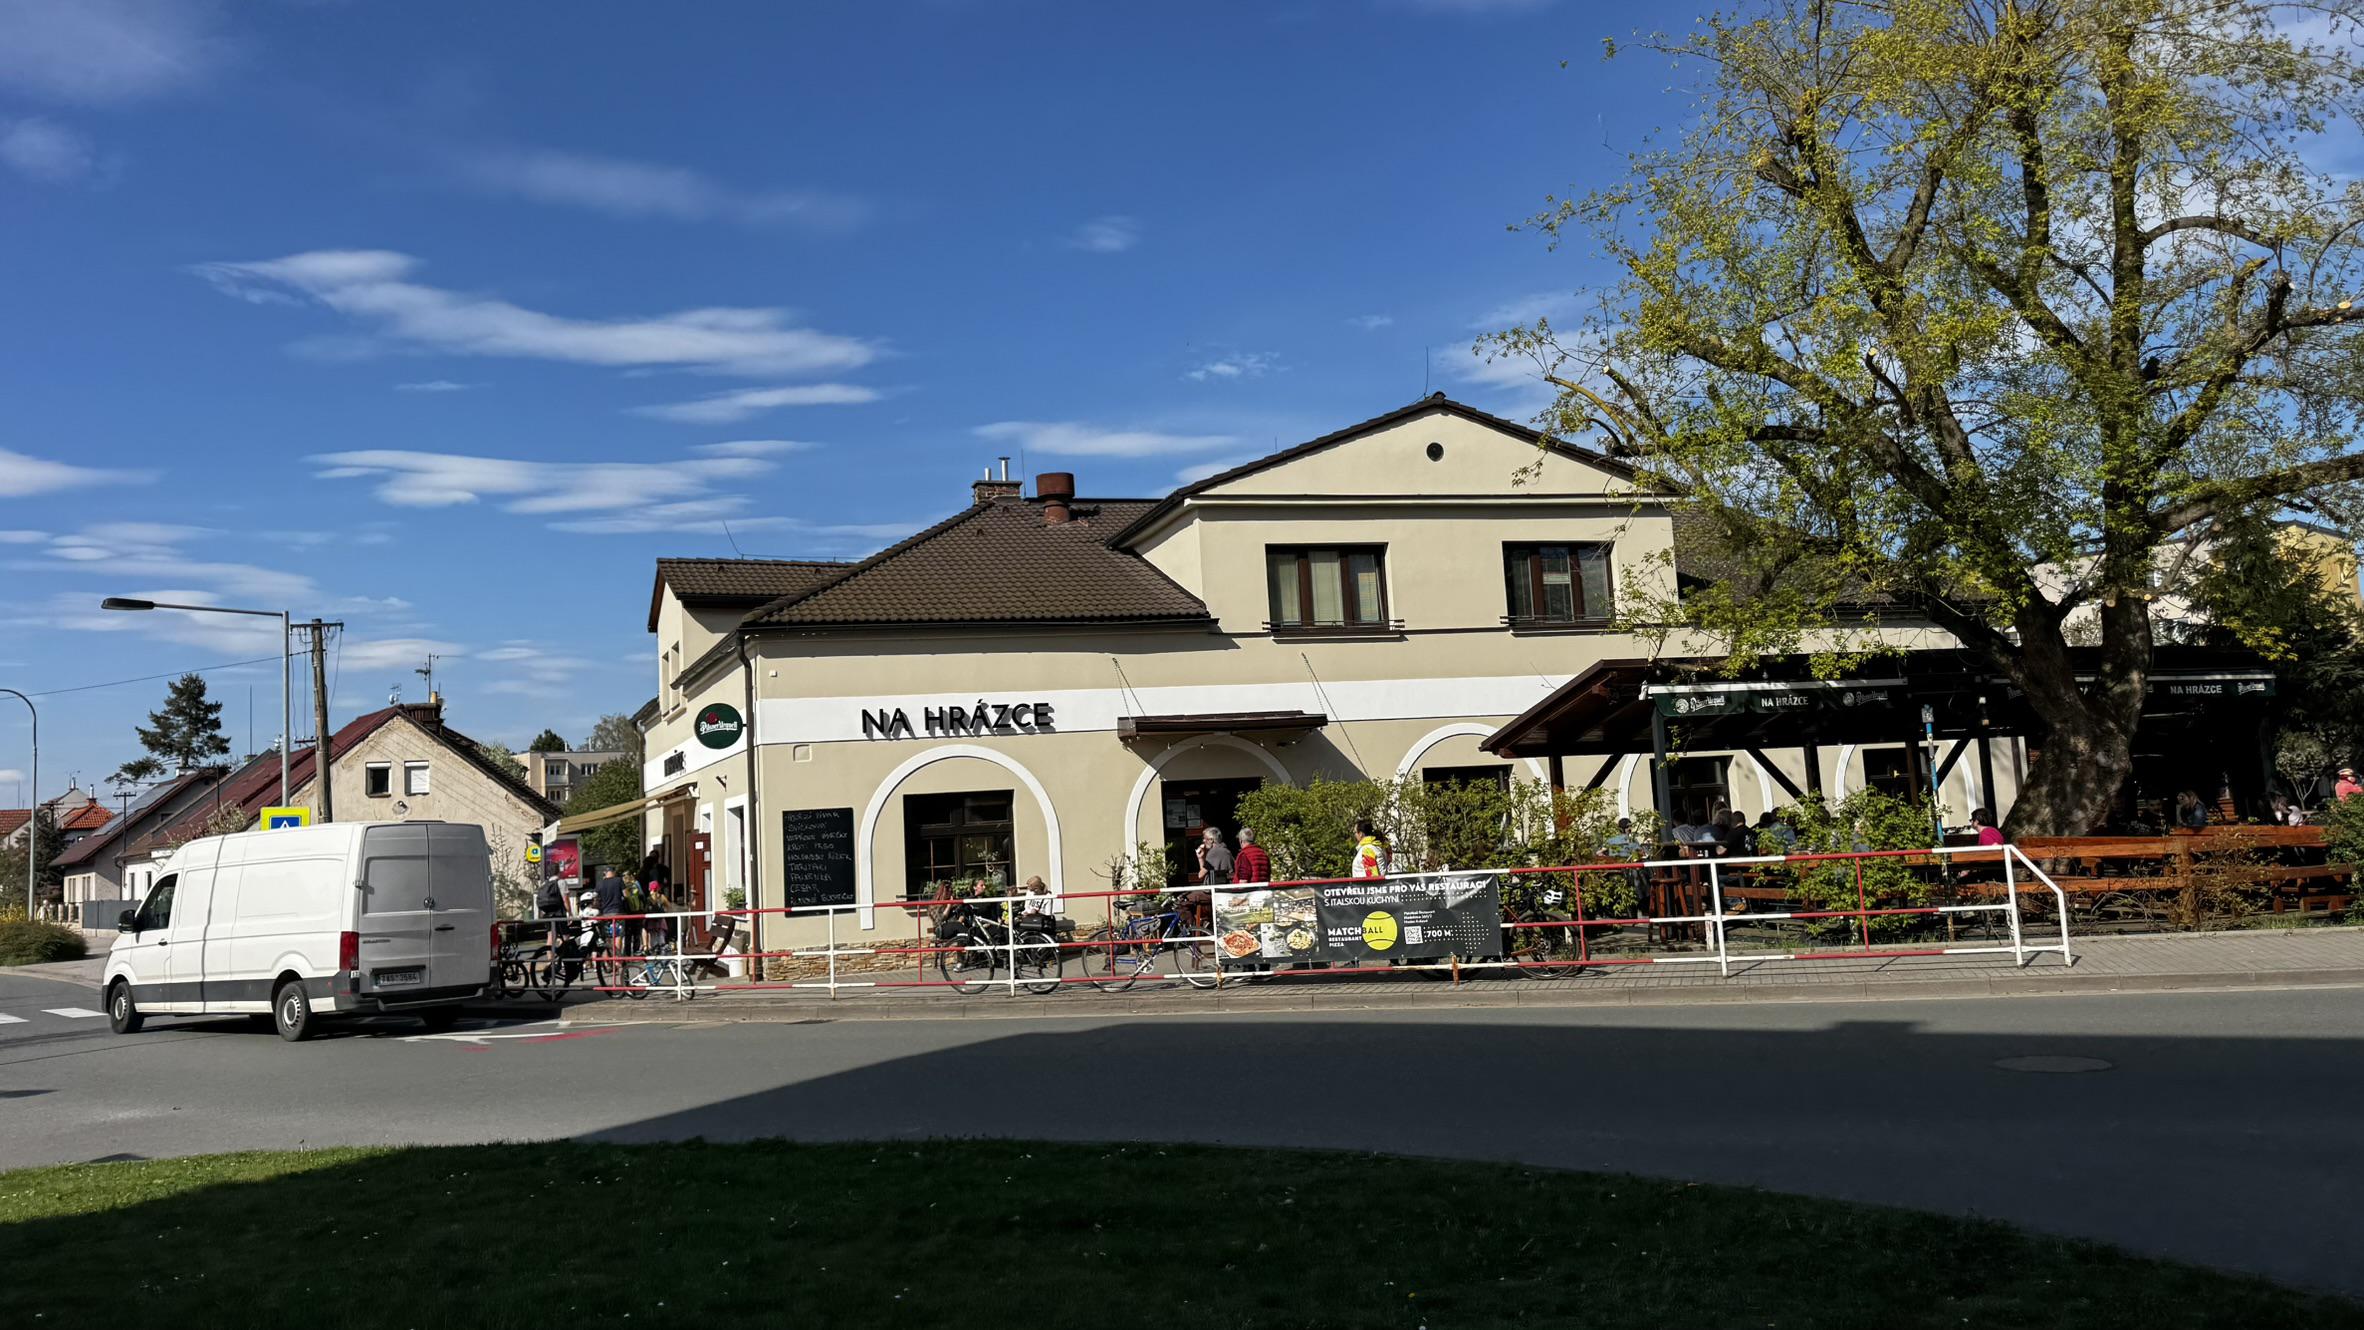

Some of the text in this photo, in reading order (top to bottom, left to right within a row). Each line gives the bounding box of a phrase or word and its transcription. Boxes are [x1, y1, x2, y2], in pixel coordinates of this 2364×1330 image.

[2170, 684, 2222, 694] NA HRÁZCE
[1761, 694, 1809, 707] NA HRÁZCE
[862, 698, 1051, 733] NA HRÁZCE
[1324, 880, 1487, 897] OTEVŘELI JSME PRO VÁS RESTAURACI
[1324, 893, 1400, 907] S ITALSKOU KUCHYNÍ
[1426, 930, 1443, 938] 700
